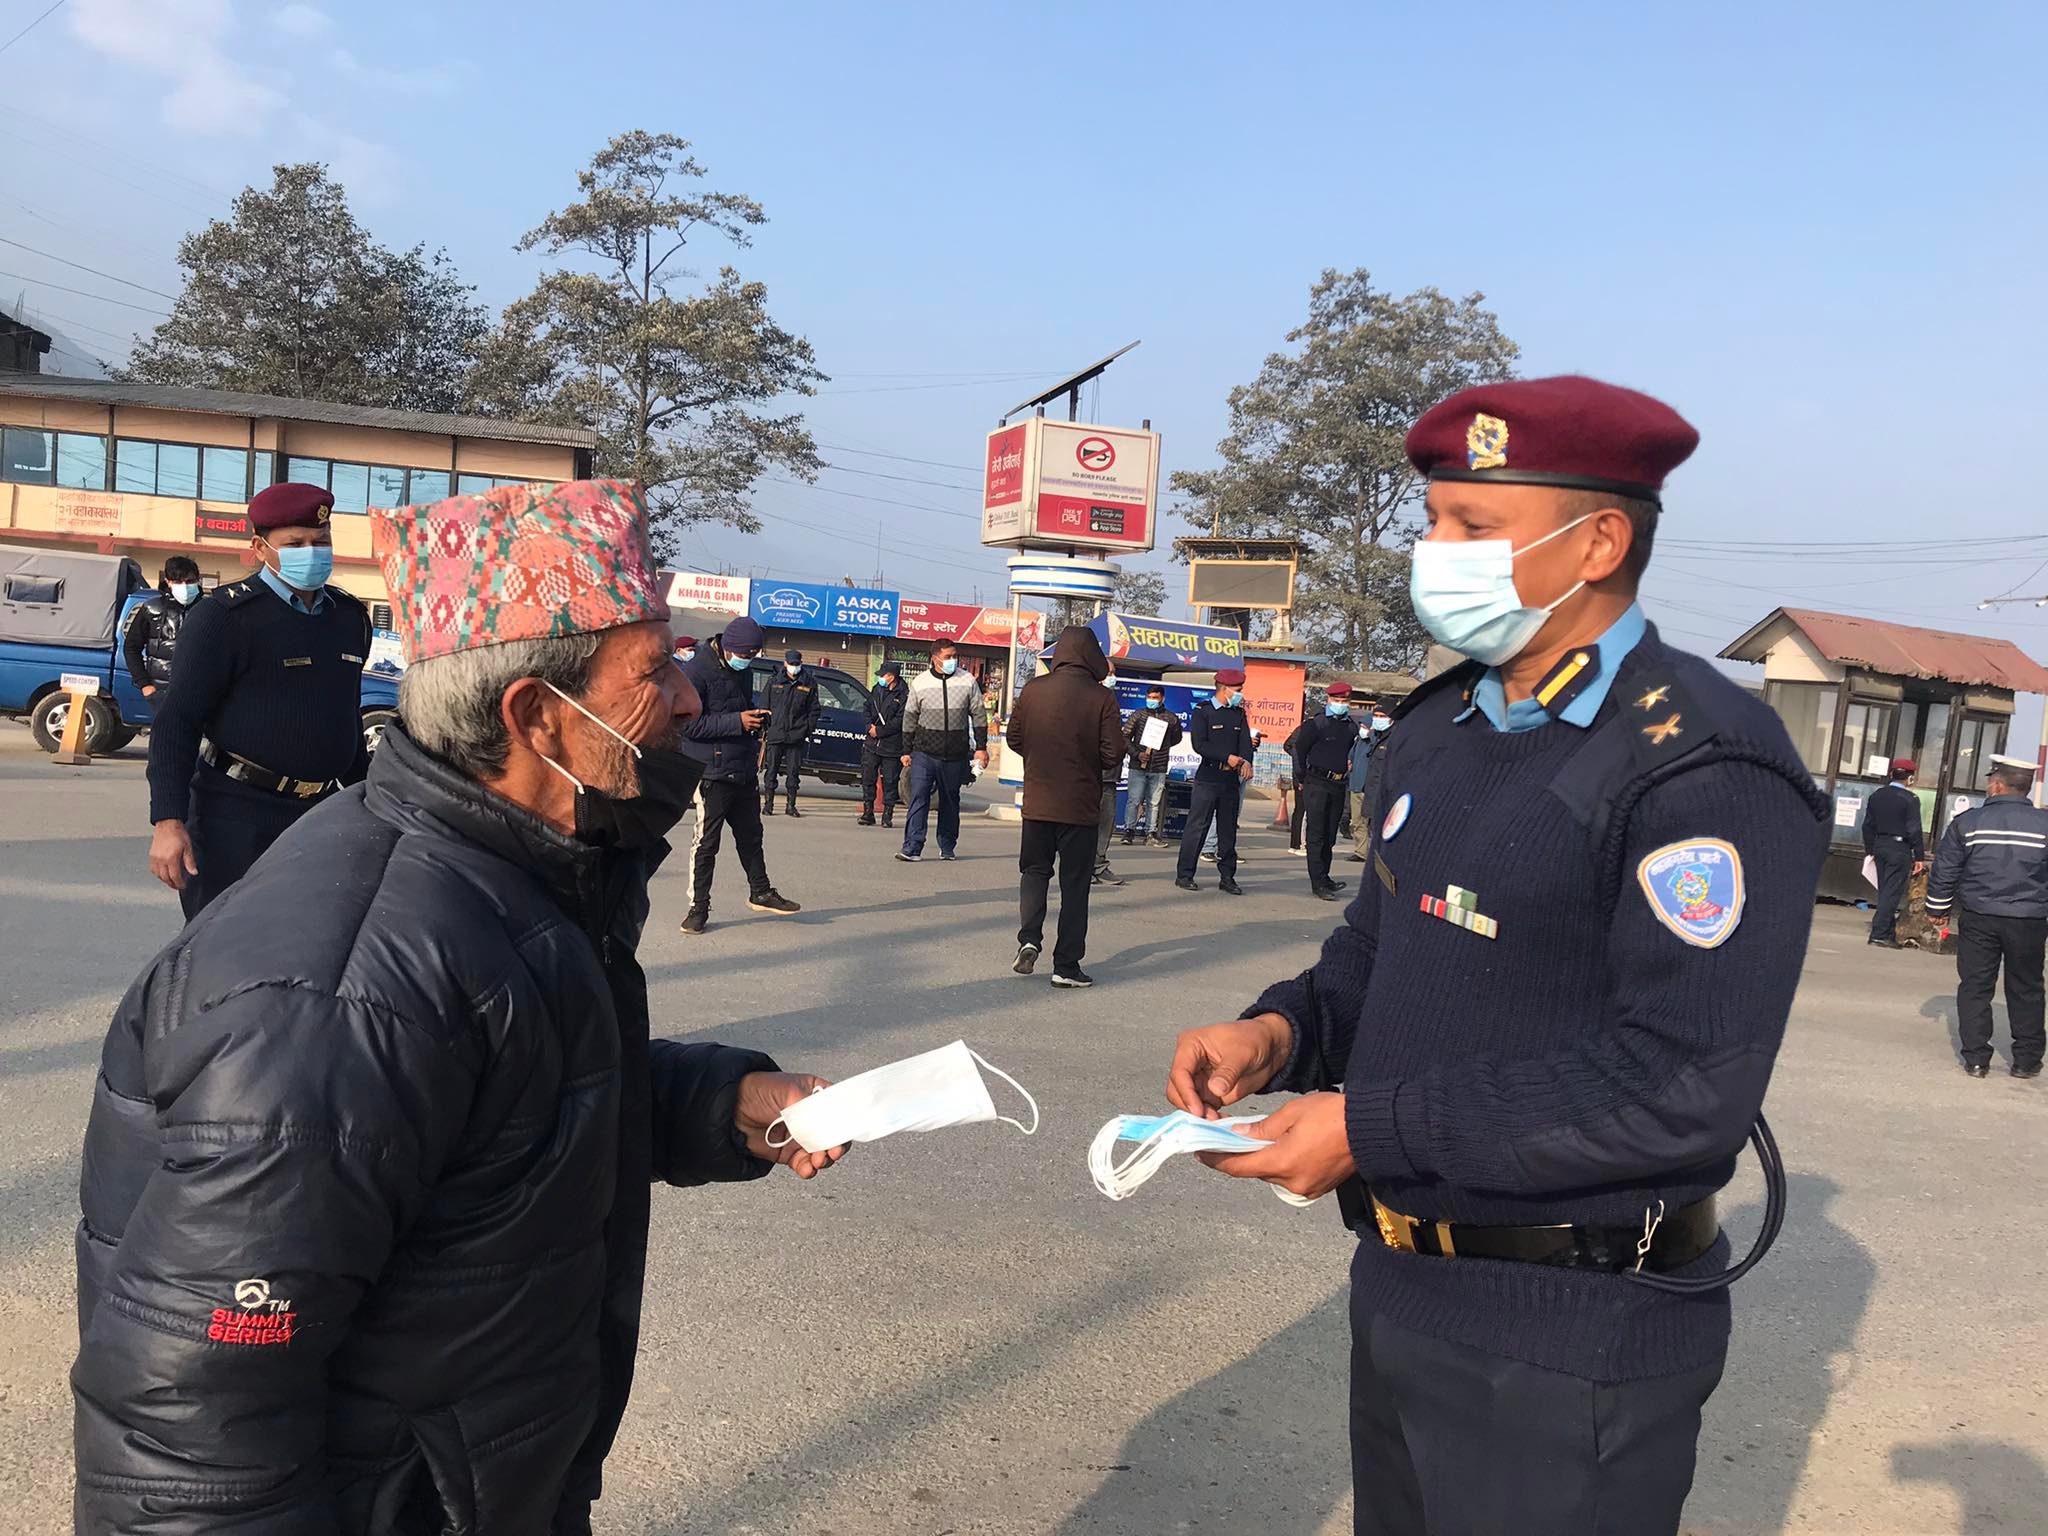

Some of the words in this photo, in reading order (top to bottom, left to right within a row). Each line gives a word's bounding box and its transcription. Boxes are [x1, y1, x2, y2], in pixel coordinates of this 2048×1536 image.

[1095, 474, 1117, 482] PLEASE
[695, 576, 729, 589] BIBEK
[714, 591, 743, 602] GHAR
[769, 595, 794, 607] Nepal
[796, 598, 809, 608] Ice
[836, 595, 892, 611] AASKA
[902, 604, 928, 616] पाण्डे
[837, 610, 889, 625] STORE
[901, 618, 931, 631] कोल्ड
[933, 621, 958, 633] स्टोर
[1129, 625, 1200, 652] सहायता
[1203, 635, 1240, 658] कक्ष
[1257, 698, 1295, 712] शौचालय
[1251, 715, 1295, 727] TOILET
[269, 1300, 291, 1312] TM
[211, 1308, 297, 1328] SUMMIT
[207, 1324, 293, 1345] SERIES
